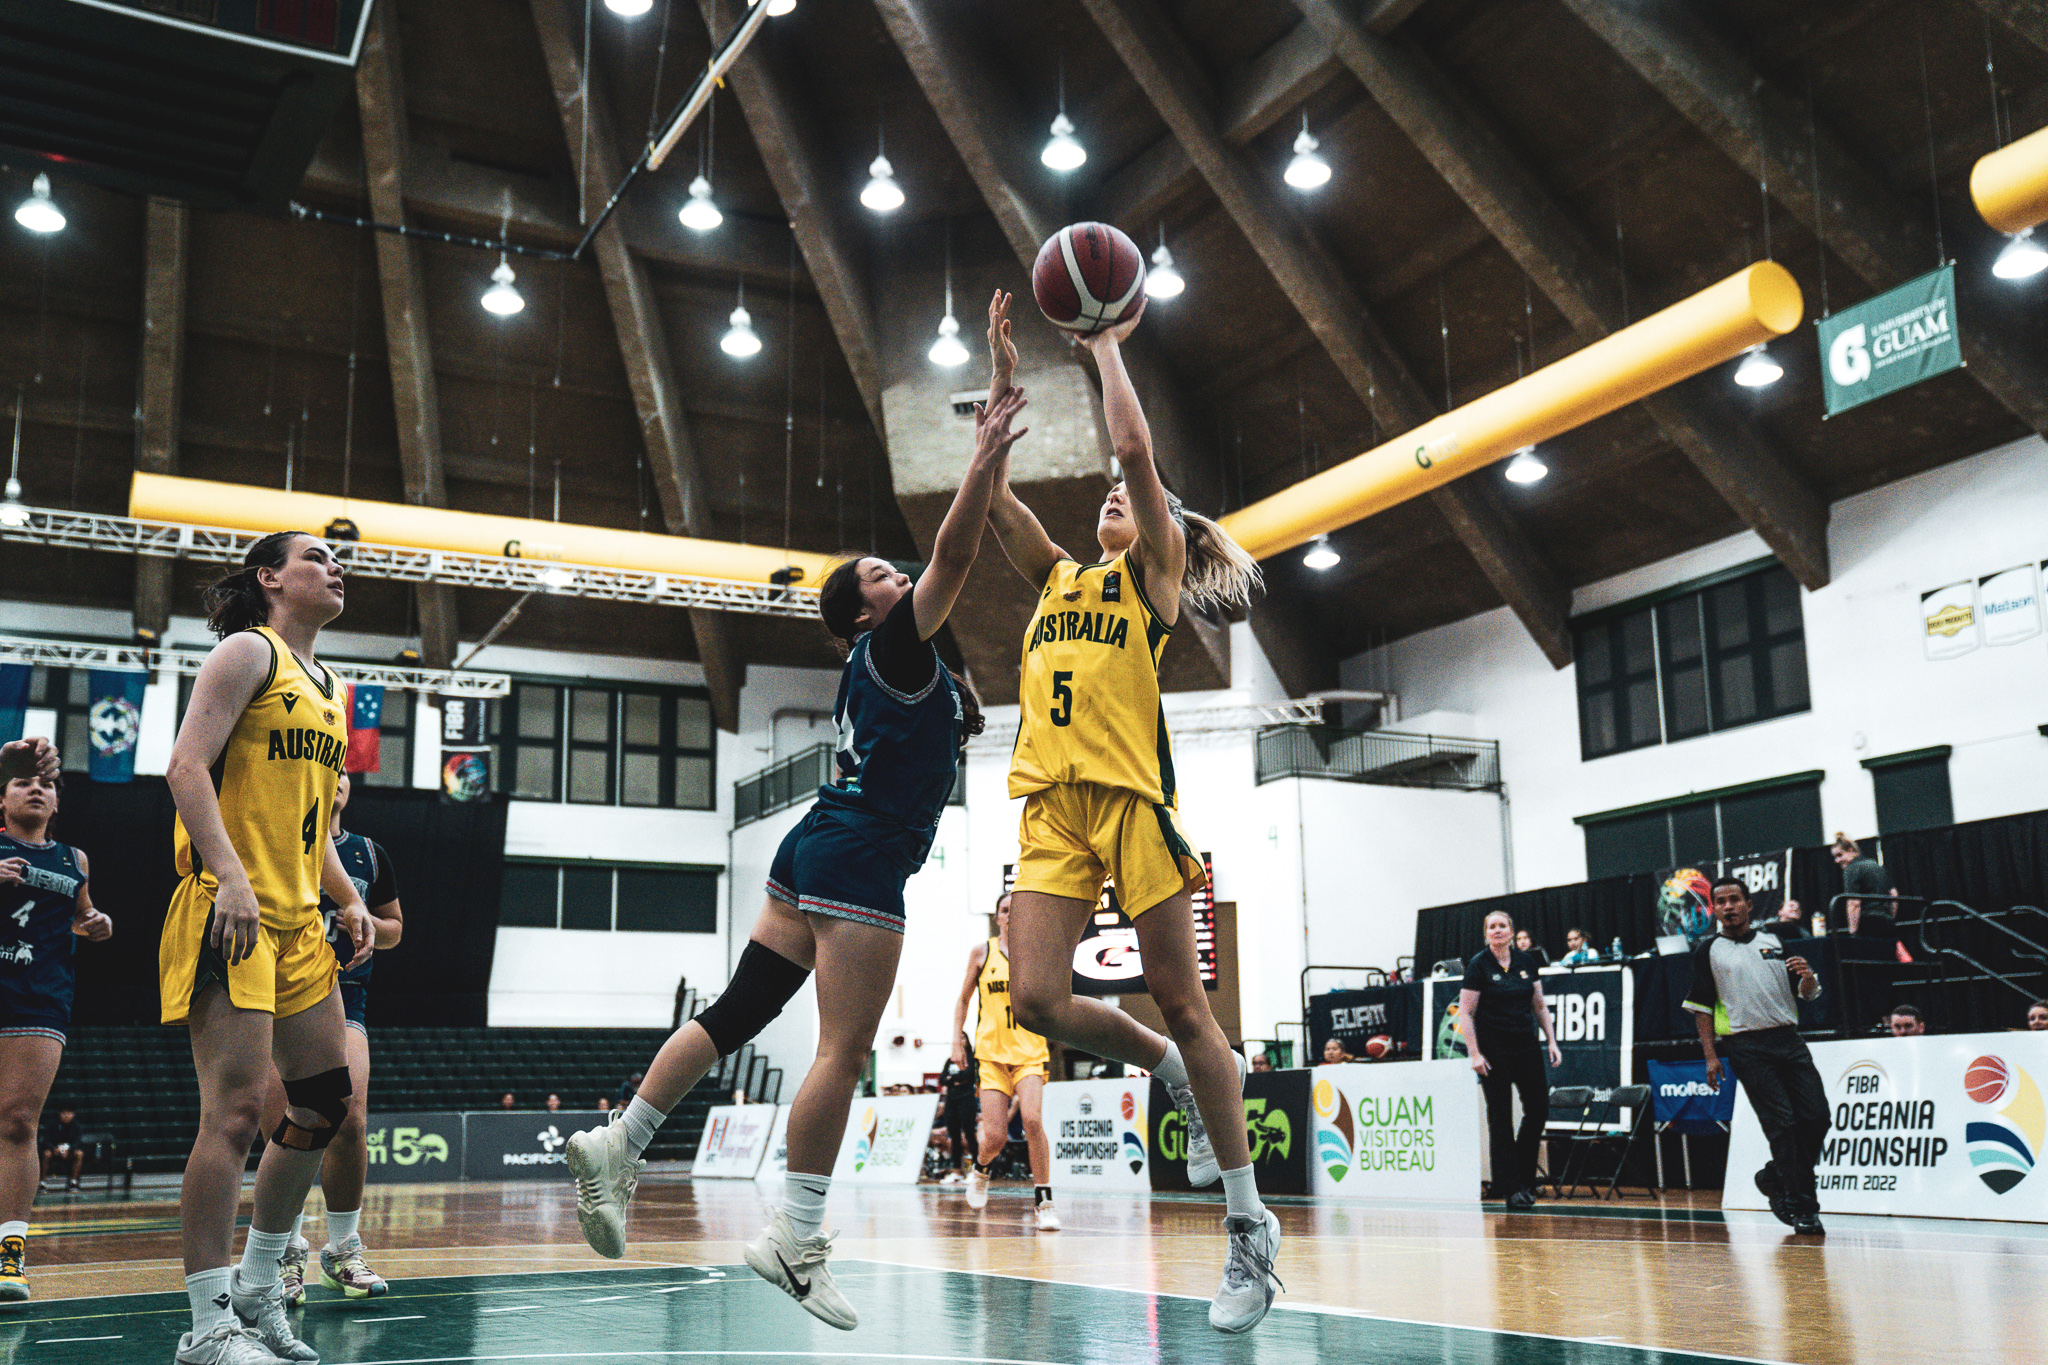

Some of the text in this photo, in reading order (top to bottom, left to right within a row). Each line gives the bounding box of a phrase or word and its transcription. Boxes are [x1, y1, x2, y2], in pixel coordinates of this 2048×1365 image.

[1873, 309, 1950, 358] GUAM
[1028, 611, 1129, 653] AUSTRALIA
[1050, 671, 1073, 727] 5
[445, 700, 464, 740] FIBA
[268, 728, 346, 779] AUSTRAL
[302, 797, 319, 855] 4
[931, 846, 944, 869] 4
[11, 900, 36, 928] 4
[1331, 1003, 1388, 1031] GUAM
[1847, 1075, 1879, 1094] FIBA
[1359, 1096, 1433, 1127] GUAM
[1835, 1100, 1935, 1131] OCEANIA
[367, 1128, 387, 1145] of
[880, 1118, 915, 1137] GUAM
[1061, 1120, 1113, 1138] U15 OCEANIA
[1360, 1129, 1434, 1147] VISITORS
[1056, 1142, 1118, 1160] CHAMPIONSHIP
[1360, 1150, 1435, 1171] BUREAU
[1816, 1137, 1948, 1167] MPIONSHIP
[1863, 1175, 1897, 1190] 2022
